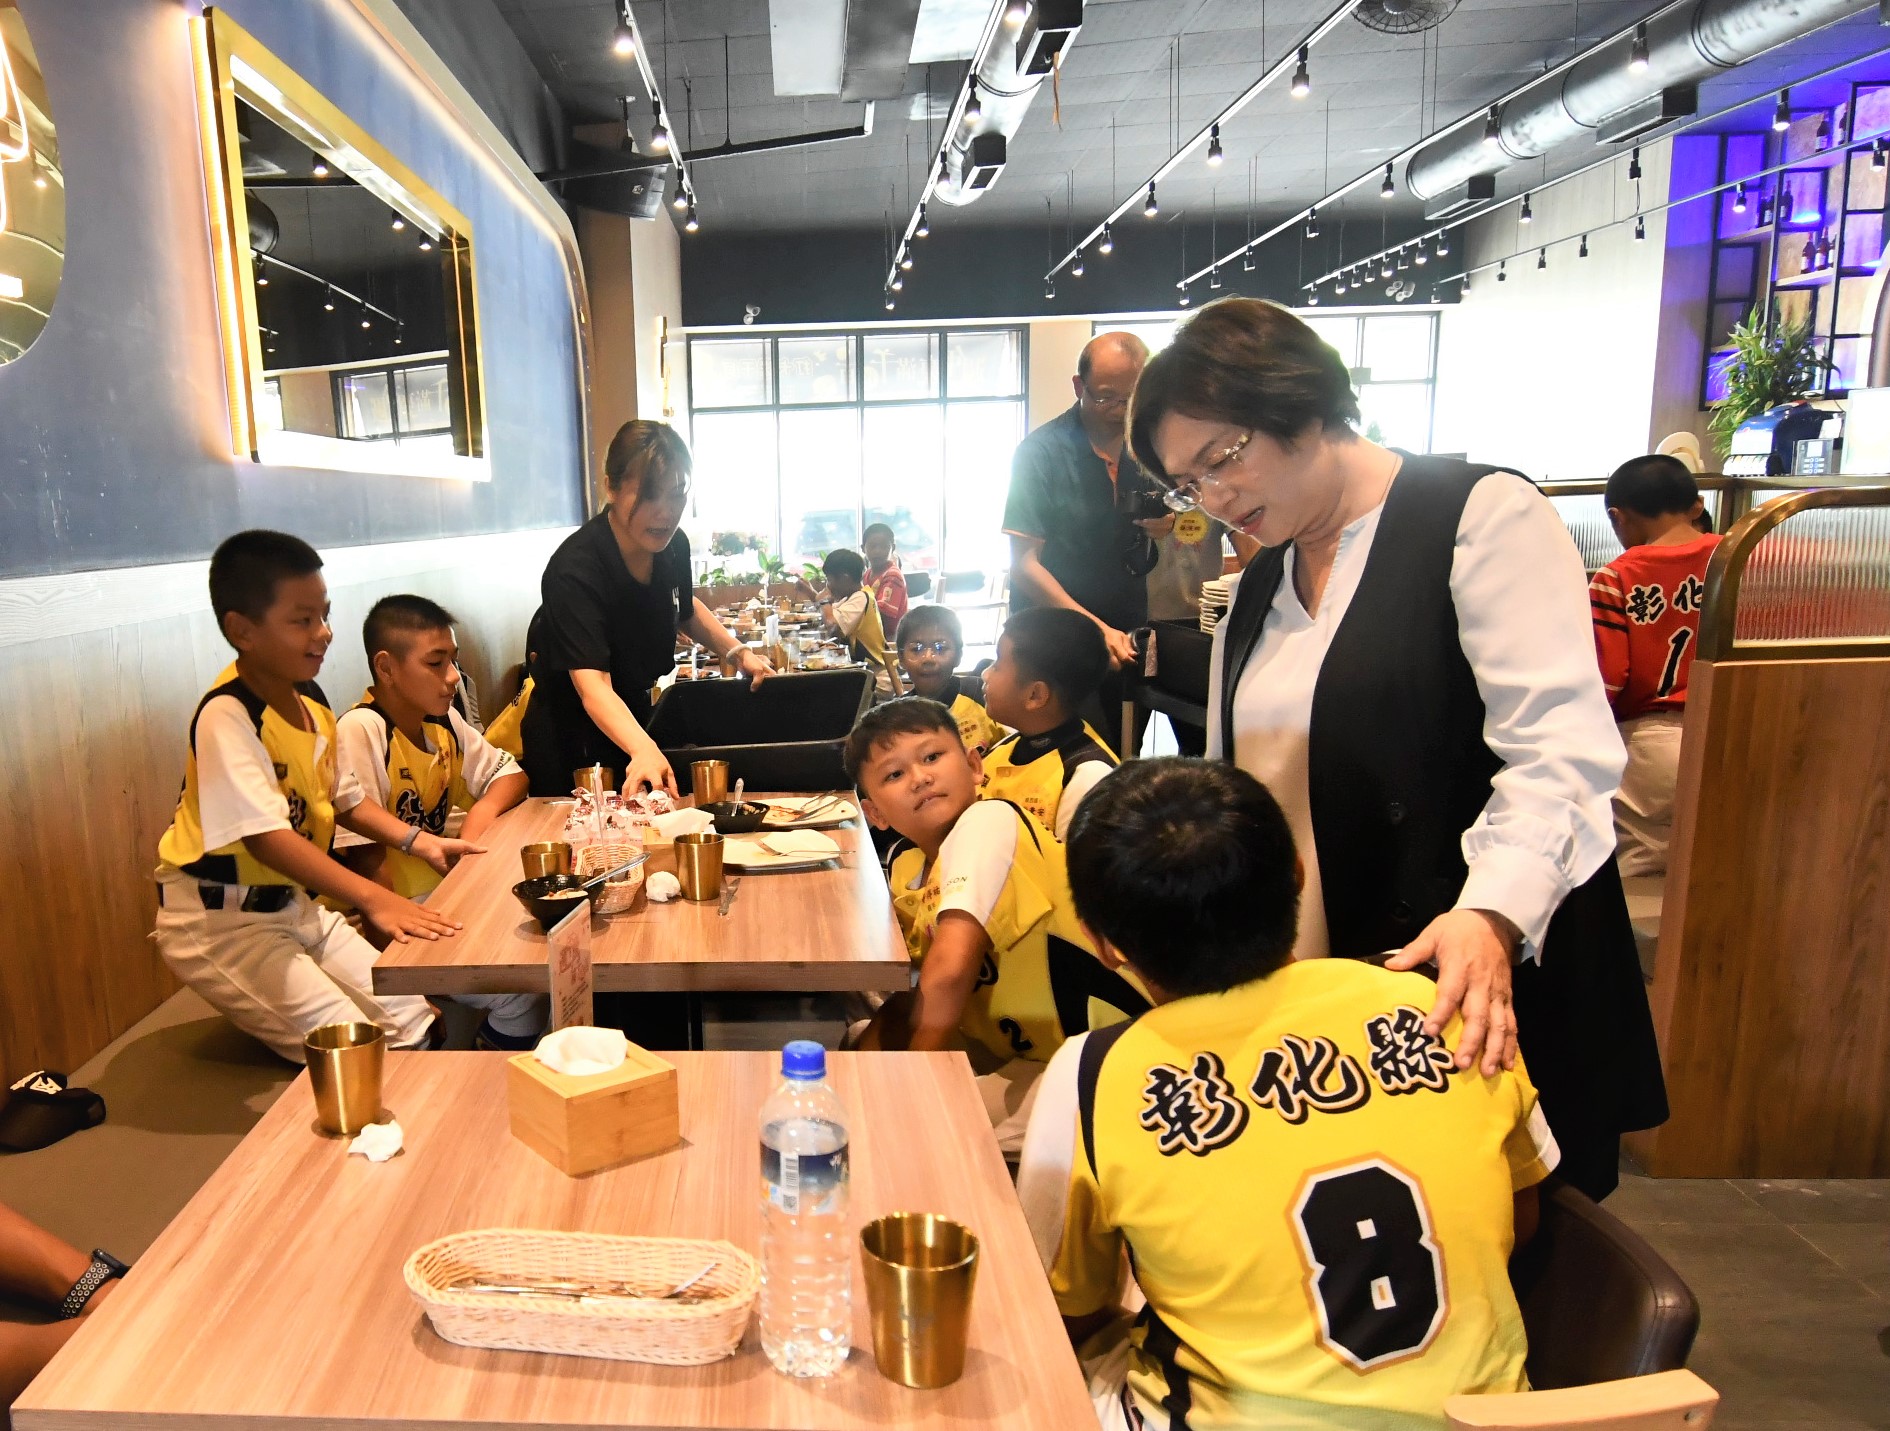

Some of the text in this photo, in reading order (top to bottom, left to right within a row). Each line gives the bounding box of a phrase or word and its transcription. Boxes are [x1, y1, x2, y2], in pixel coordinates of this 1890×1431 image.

[1625, 574, 1704, 625] 彰化
[1140, 1004, 1458, 1156] 彰化縣
[1285, 1151, 1451, 1376] 8
